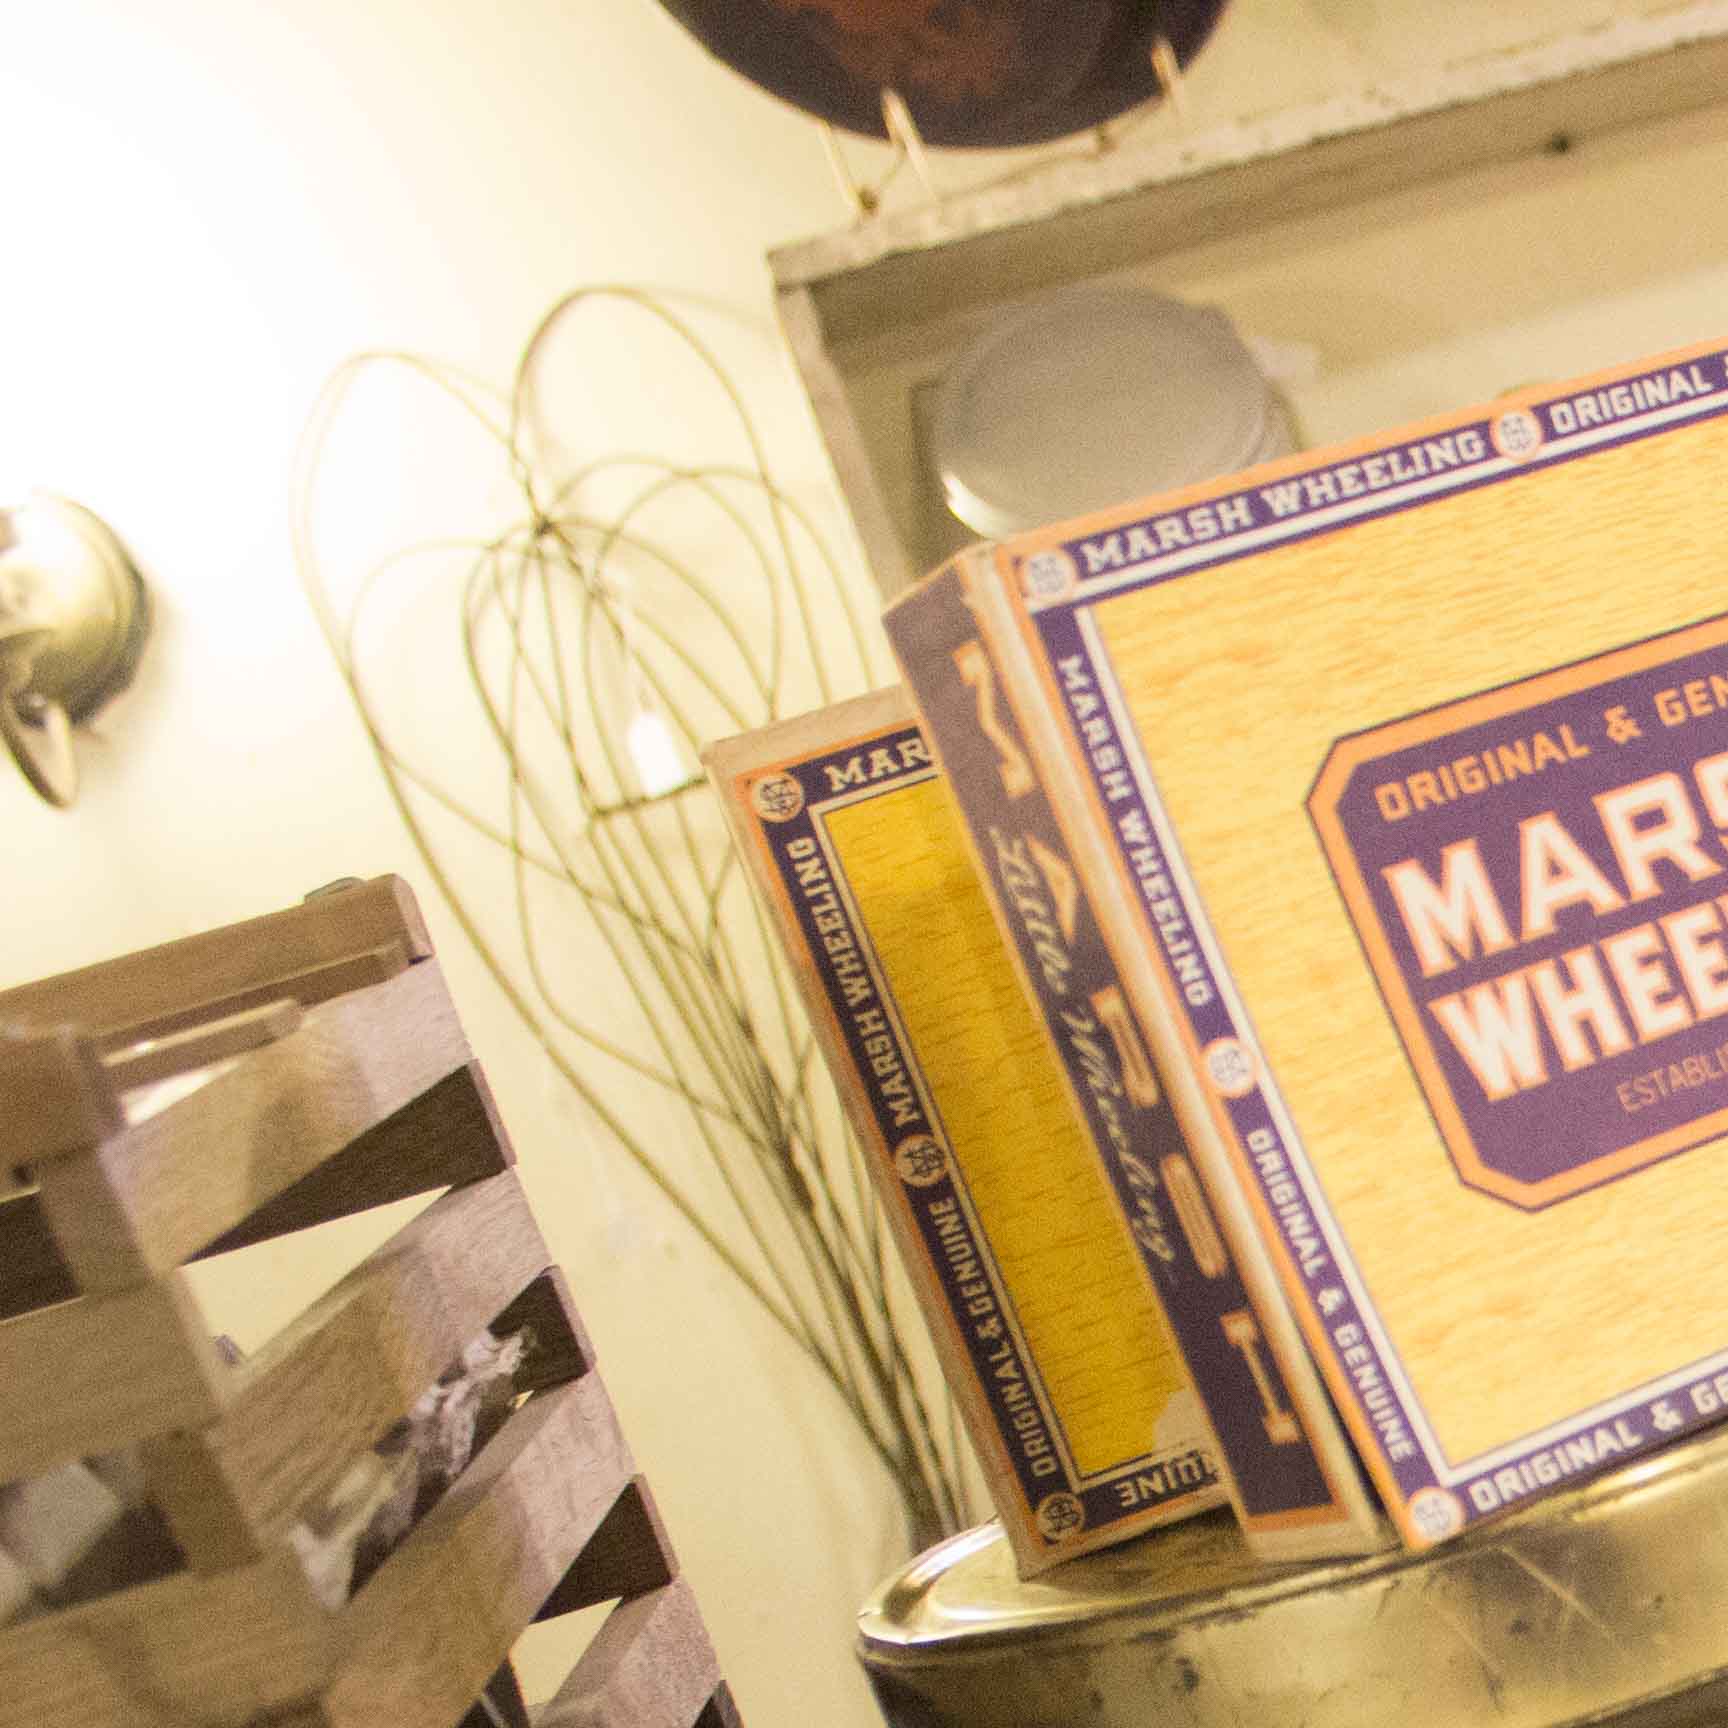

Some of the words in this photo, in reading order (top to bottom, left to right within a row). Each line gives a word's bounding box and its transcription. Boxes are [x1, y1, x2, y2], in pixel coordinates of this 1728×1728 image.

[1077, 496, 1255, 574] MARSH
[1262, 427, 1489, 518] WHEELING
[1549, 366, 1714, 436] ORIGINAL
[1057, 654, 1132, 803] MARSH
[1117, 805, 1214, 1008] WHEELING
[1374, 723, 1592, 823] ORIGINAL
[1604, 704, 1643, 745] &
[785, 835, 876, 1008] WHEELING
[856, 1009, 924, 1127] MARSH
[928, 1197, 991, 1316] GENUINE
[1246, 1127, 1329, 1280] ORIGINAL
[1317, 1286, 1346, 1318] &
[1334, 1321, 1417, 1464] GENUINE
[988, 1344, 1057, 1479] ORIGINAL
[1467, 1424, 1643, 1517] ORIGINAL
[1648, 1398, 1684, 1436] &
